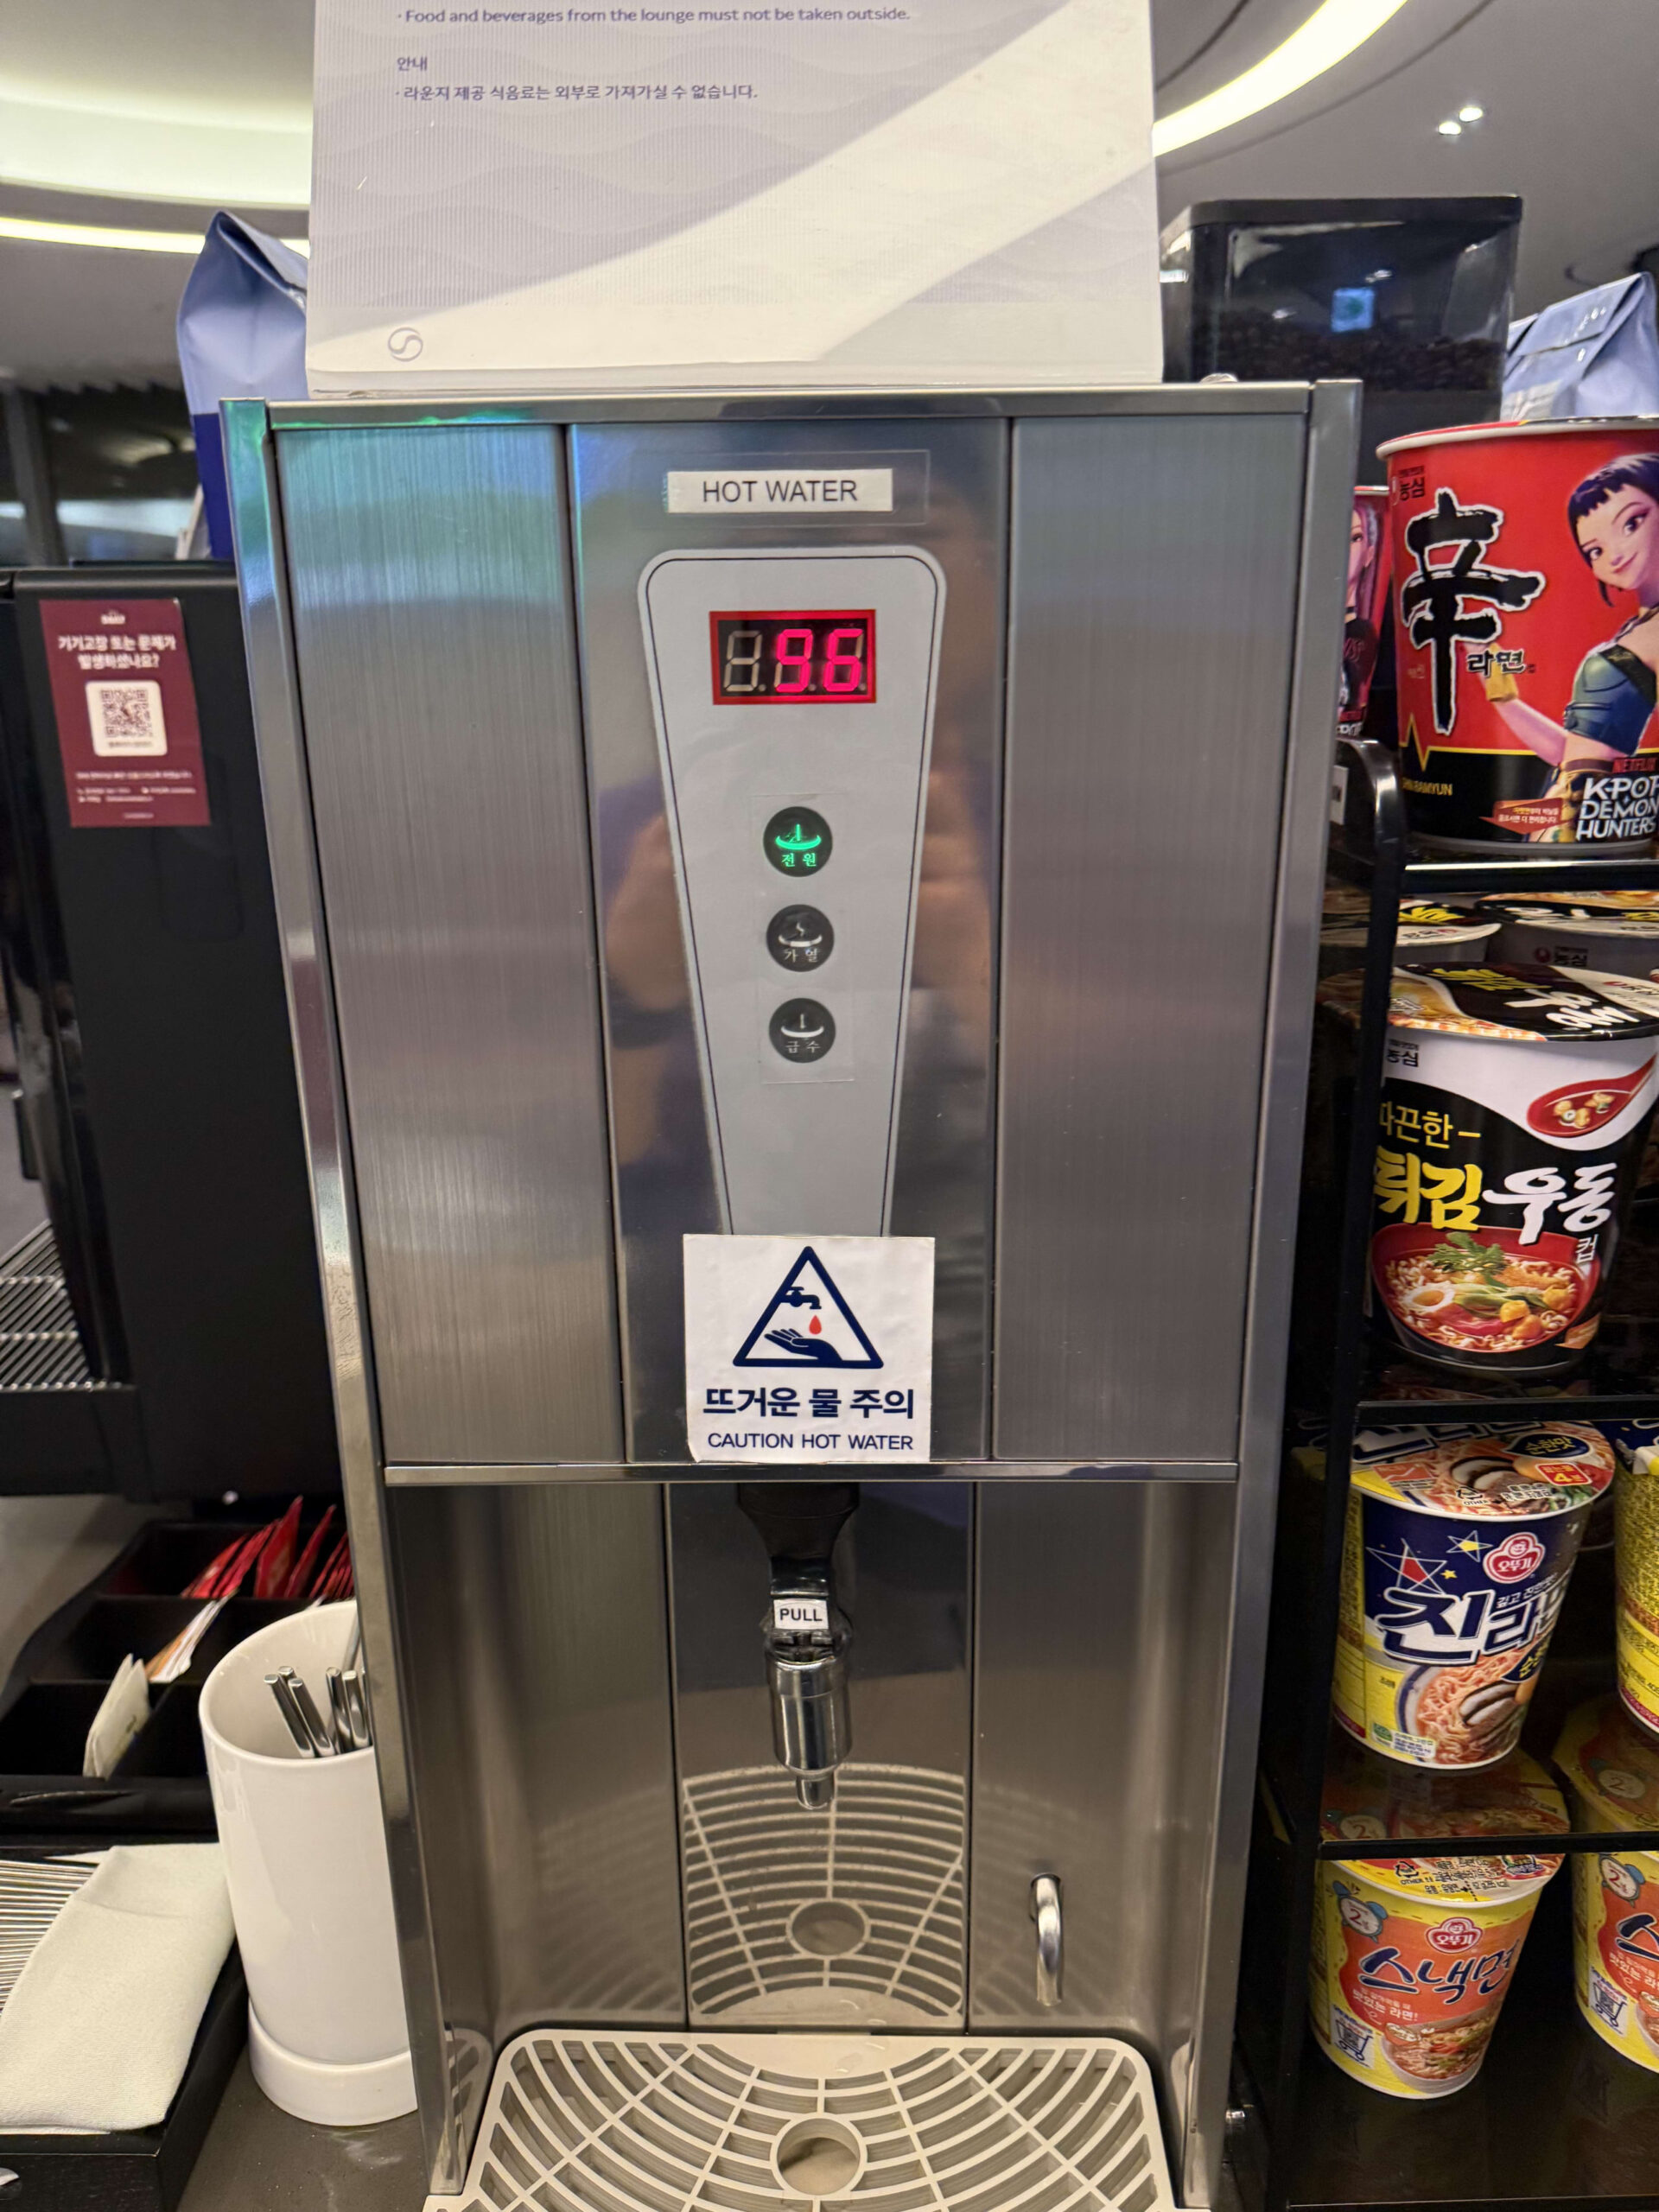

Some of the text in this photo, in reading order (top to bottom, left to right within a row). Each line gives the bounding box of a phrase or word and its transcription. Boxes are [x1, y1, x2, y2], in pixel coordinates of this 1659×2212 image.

[405, 8, 910, 24] Food and beverages from the lounge must not be taken outside.
[397, 57, 428, 71] 안내
[404, 85, 758, 100] 라운지 제공 식음료는 외부로 가져가실 수 없습니다.
[702, 480, 858, 502] HOT WATER
[1400, 477, 1425, 501] 농심
[1401, 487, 1546, 736] 辛
[1467, 649, 1526, 677] 라면
[1580, 797, 1659, 820] DEMON
[1576, 816, 1656, 841] HUNTERS
[781, 852, 817, 868] 전원
[1387, 1049, 1419, 1067] 농심
[1575, 1234, 1598, 1264] 컵
[702, 1387, 914, 1420] 뜨거운 물 주의
[708, 1433, 914, 1451] CAUTION HOT WATER
[1523, 1435, 1576, 1455] 순한맛
[1497, 1560, 1533, 1573] 오뚜기
[779, 1608, 823, 1621] PULL
[1437, 1933, 1474, 1944] 오뚜기
[1359, 1940, 1520, 2005] 스낵면
